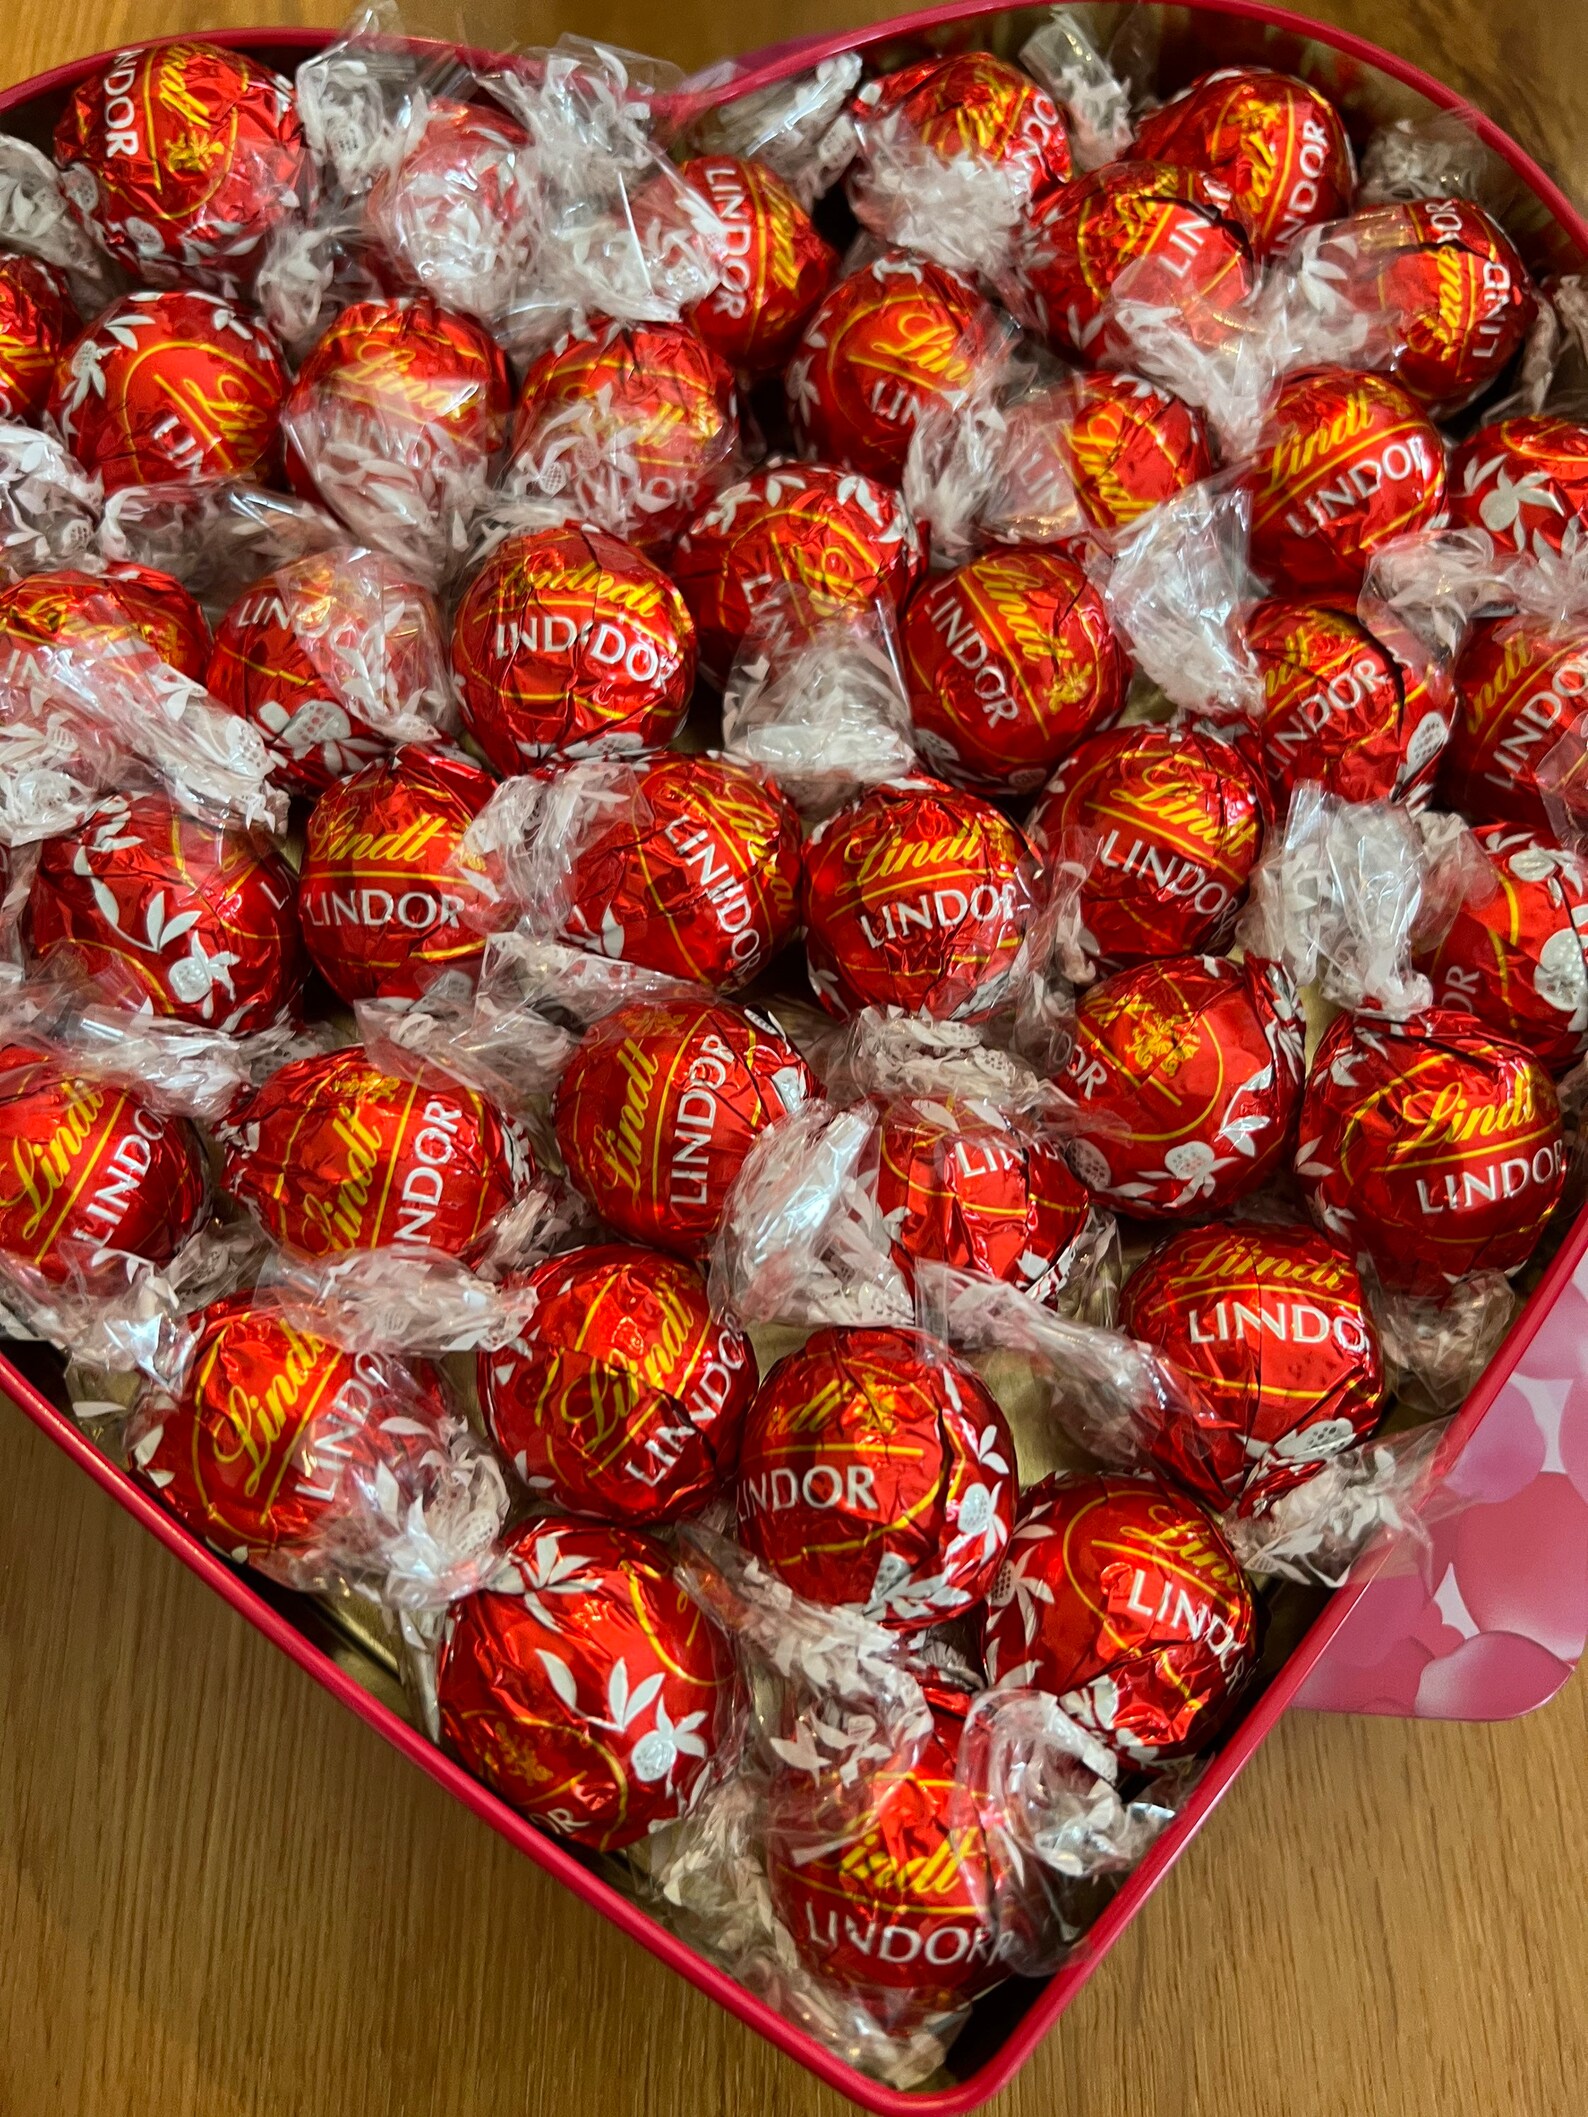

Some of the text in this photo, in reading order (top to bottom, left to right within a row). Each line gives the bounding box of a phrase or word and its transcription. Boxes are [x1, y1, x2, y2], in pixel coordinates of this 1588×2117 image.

[304, 888, 466, 930] LINDOR
[72, 1104, 168, 1248] LINDO
[392, 1100, 463, 1248] NDOR
[593, 1036, 659, 1213] Lindt
[670, 1034, 735, 1205] LINDOR
[1188, 1301, 1369, 1353] LINDO
[294, 1349, 390, 1502] LINDO
